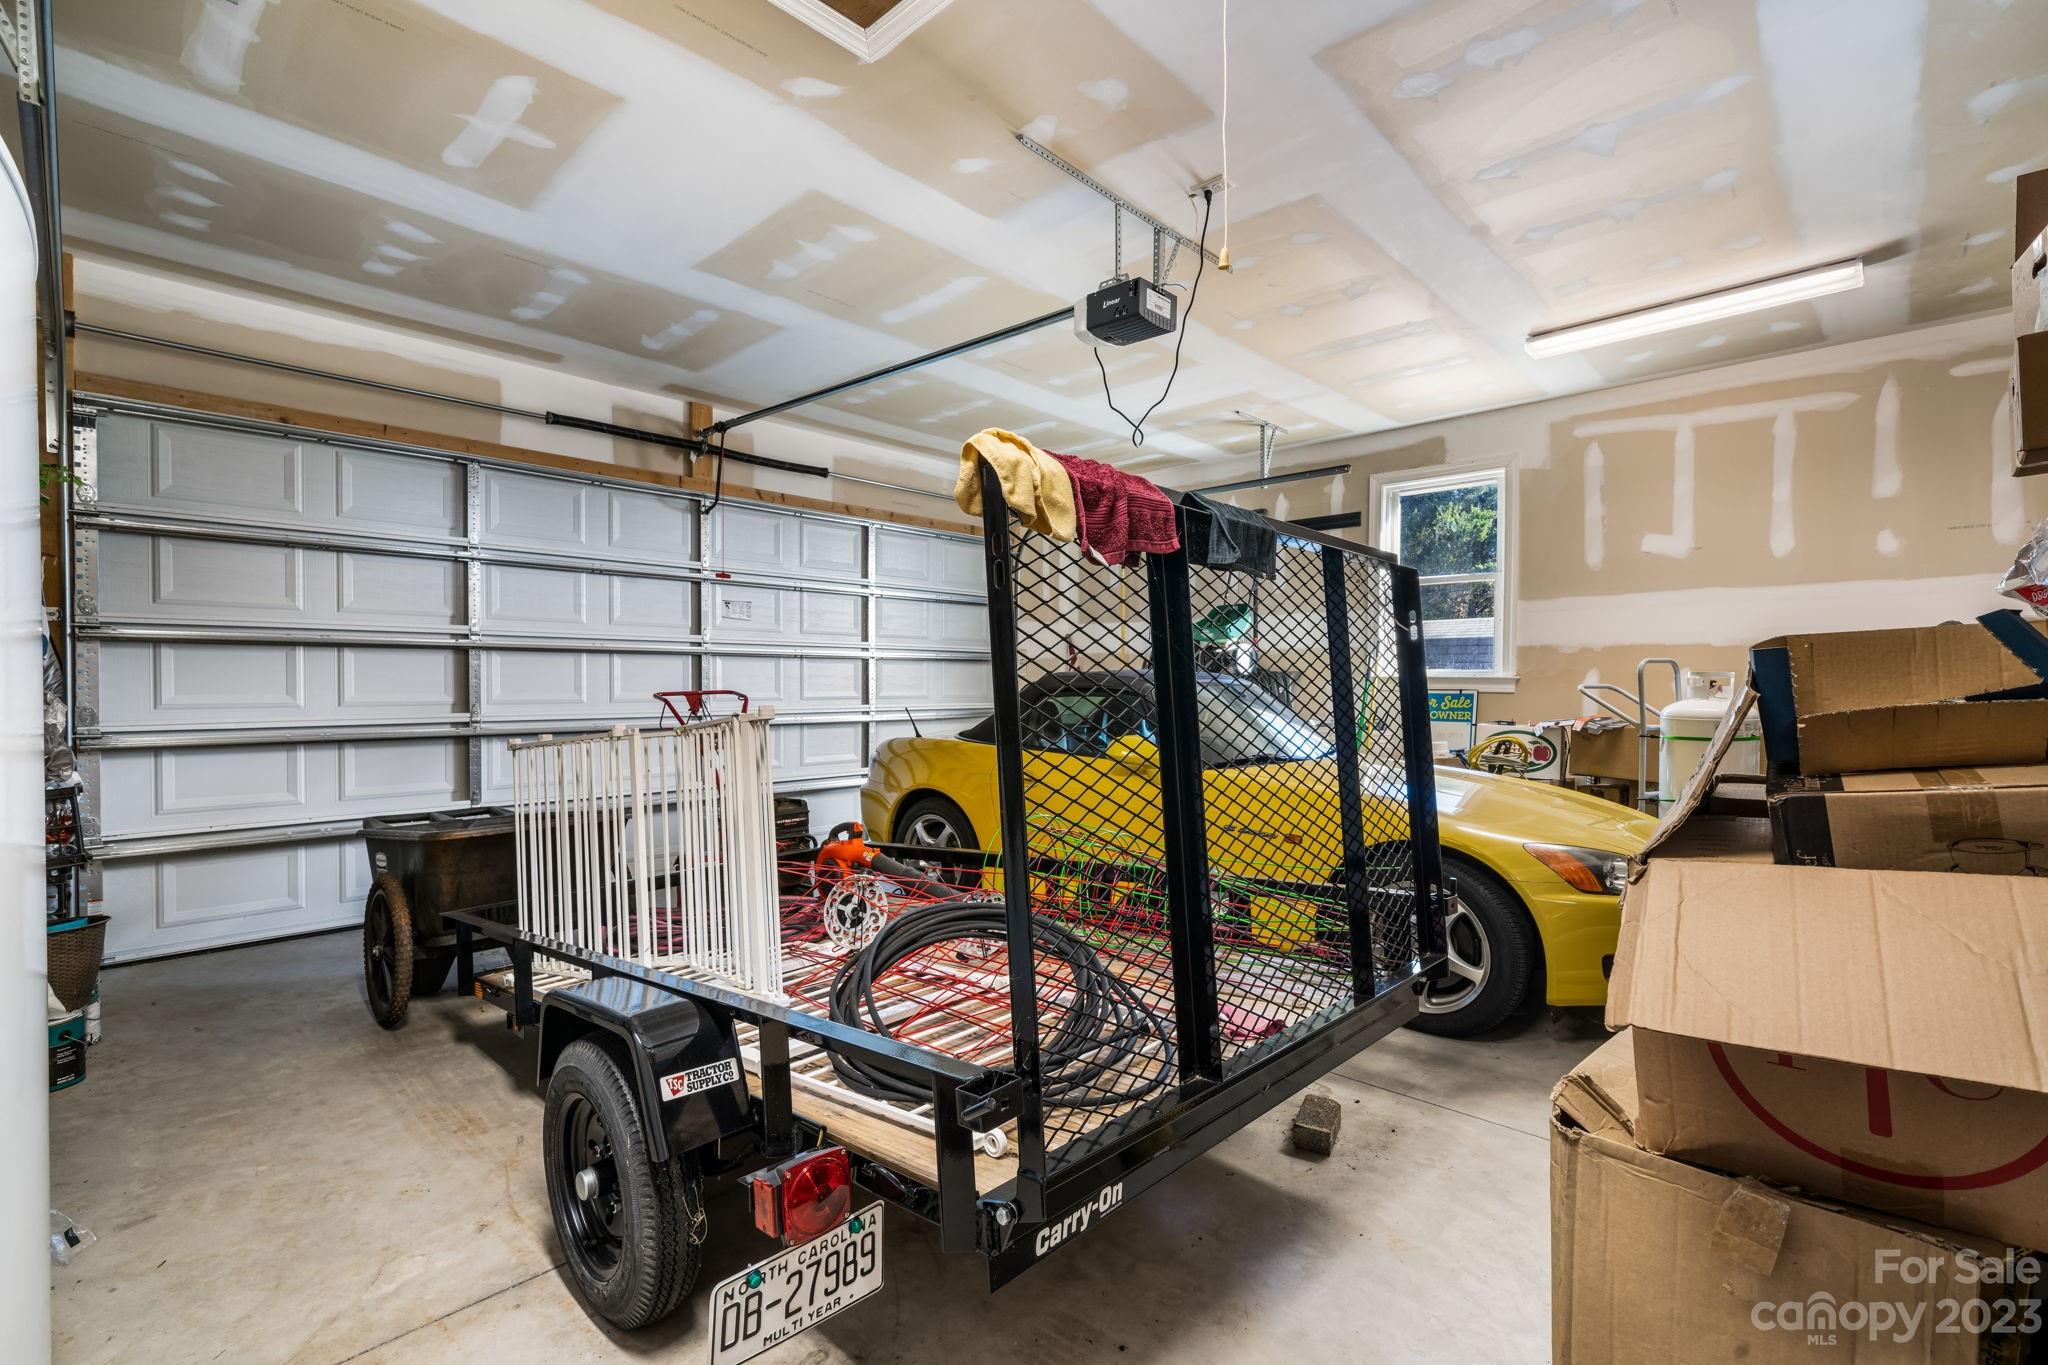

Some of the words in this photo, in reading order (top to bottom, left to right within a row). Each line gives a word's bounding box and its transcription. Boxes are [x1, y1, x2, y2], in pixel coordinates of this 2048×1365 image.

[1102, 297, 1121, 309] Linear
[1441, 695, 1472, 710] Sale
[1430, 711, 1471, 720] OWNER
[685, 1061, 732, 1082] TRACTOR
[667, 1078, 684, 1091] TSC
[686, 1073, 723, 1092] SUPPLY
[1035, 1182, 1123, 1256] Carry-On
[720, 1231, 876, 1352] DB-27989
[763, 1317, 803, 1346] MULTI
[808, 1297, 841, 1321] YEAR
